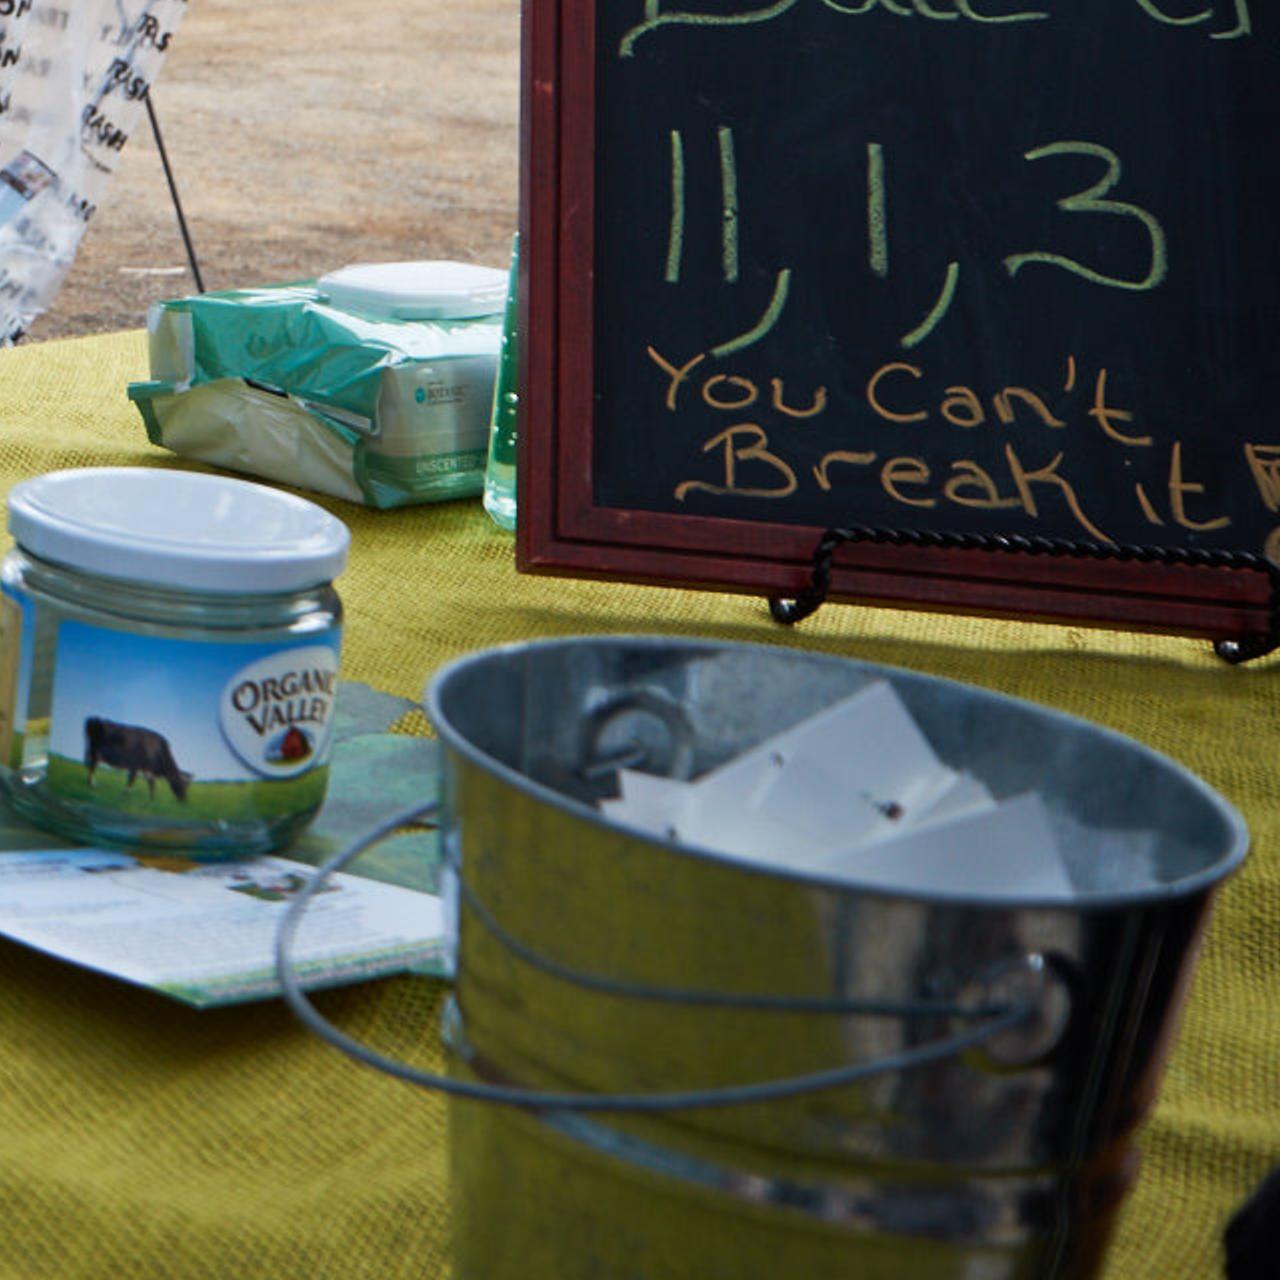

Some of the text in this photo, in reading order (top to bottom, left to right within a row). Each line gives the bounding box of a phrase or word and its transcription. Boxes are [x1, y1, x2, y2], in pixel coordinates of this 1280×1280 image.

[666, 127, 1169, 358] 11, 1, 3
[647, 345, 1153, 448] You Can't
[674, 423, 1118, 545] Break
